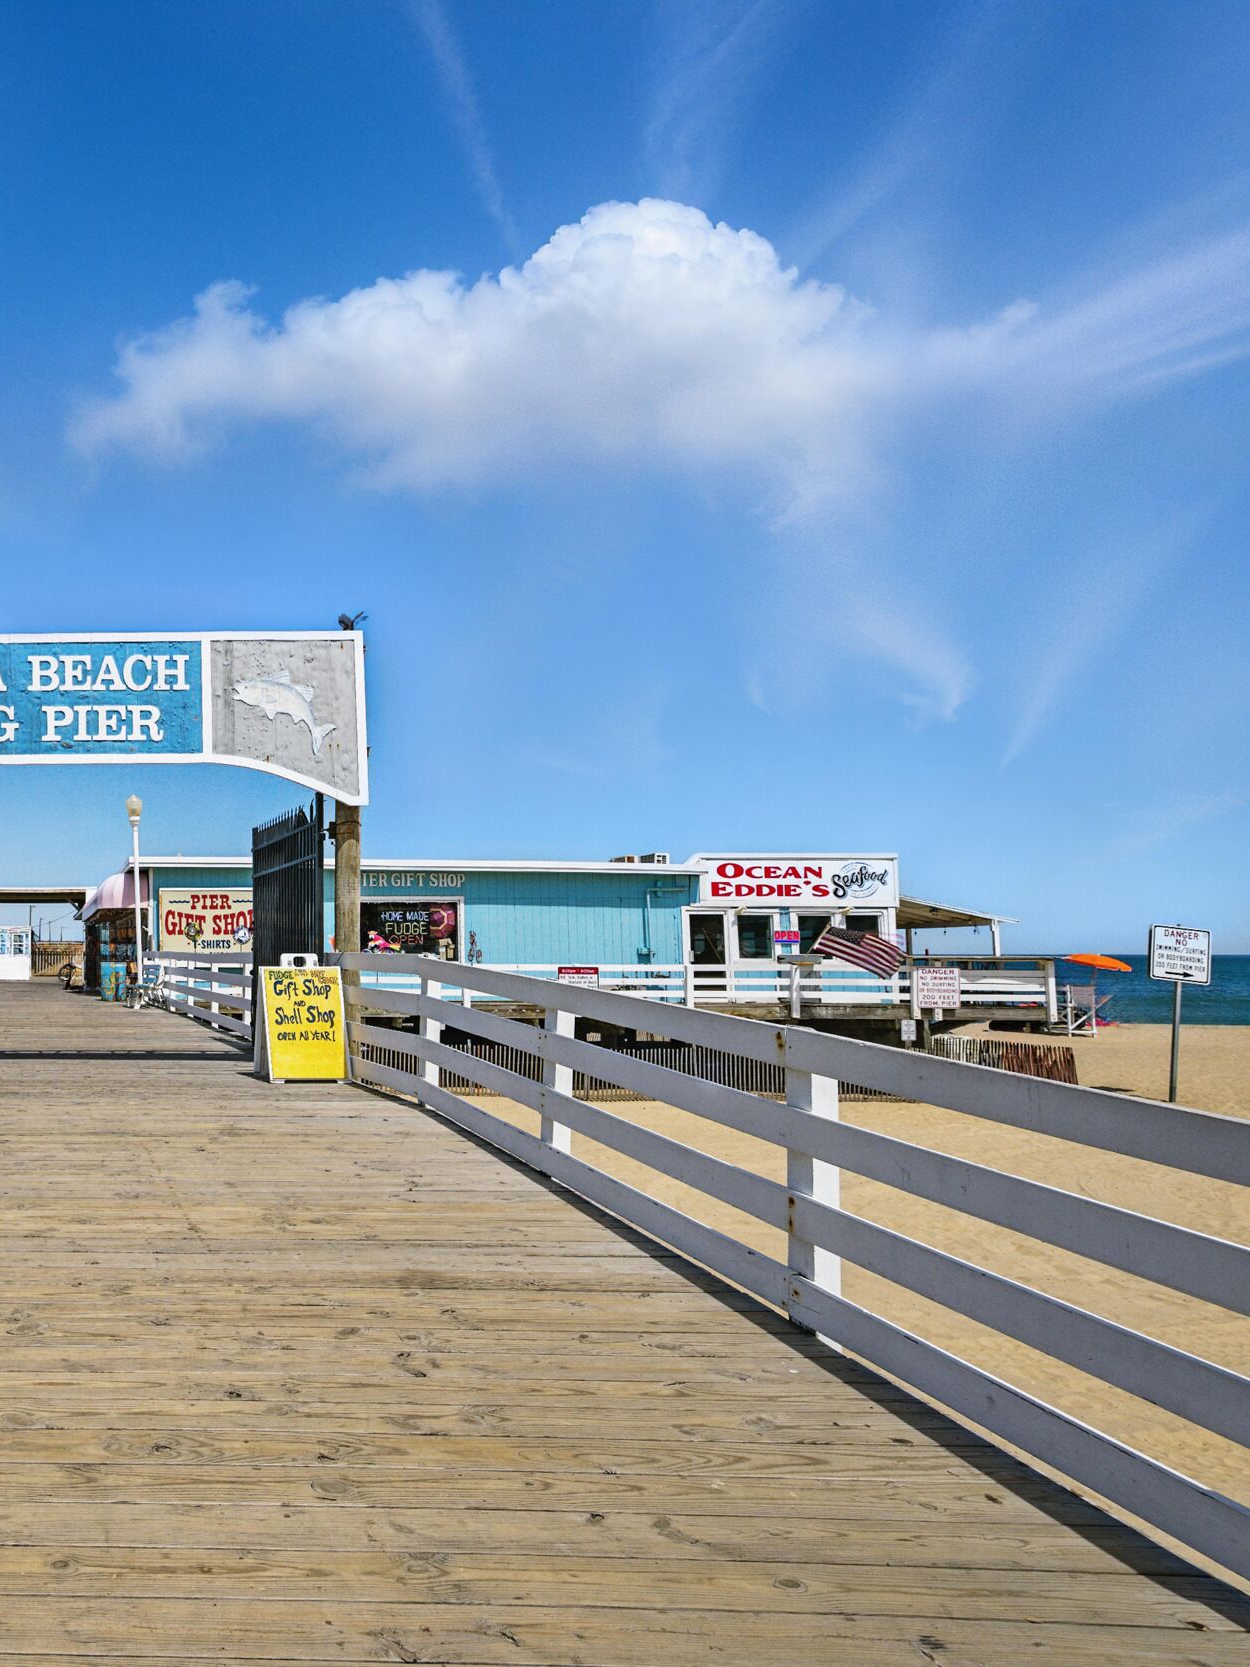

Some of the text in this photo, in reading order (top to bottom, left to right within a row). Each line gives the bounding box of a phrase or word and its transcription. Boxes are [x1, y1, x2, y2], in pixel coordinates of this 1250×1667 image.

[27, 654, 190, 692] BEACH
[41, 704, 164, 742] PIER
[716, 862, 823, 879] OCEAN
[361, 872, 466, 889] IER GIFT SHOP
[831, 865, 889, 899] Seafood
[711, 880, 830, 898] EDDIE'S
[190, 894, 232, 910] PIER
[381, 911, 430, 922] HOME MADE
[385, 921, 429, 935] FUDGE
[774, 930, 800, 940] OPEN
[1164, 929, 1199, 941] DANGER
[389, 935, 425, 945] OPEN
[1175, 938, 1188, 947] NO
[1166, 962, 1179, 970] FEET
[1179, 963, 1193, 971] FROM
[1194, 965, 1206, 973] PIER
[269, 971, 294, 980] FUDGE
[273, 980, 299, 1001] Gift
[302, 979, 332, 1000] Shop
[275, 1005, 335, 1029] Shell Shop
[277, 1031, 296, 1041] OPEN
